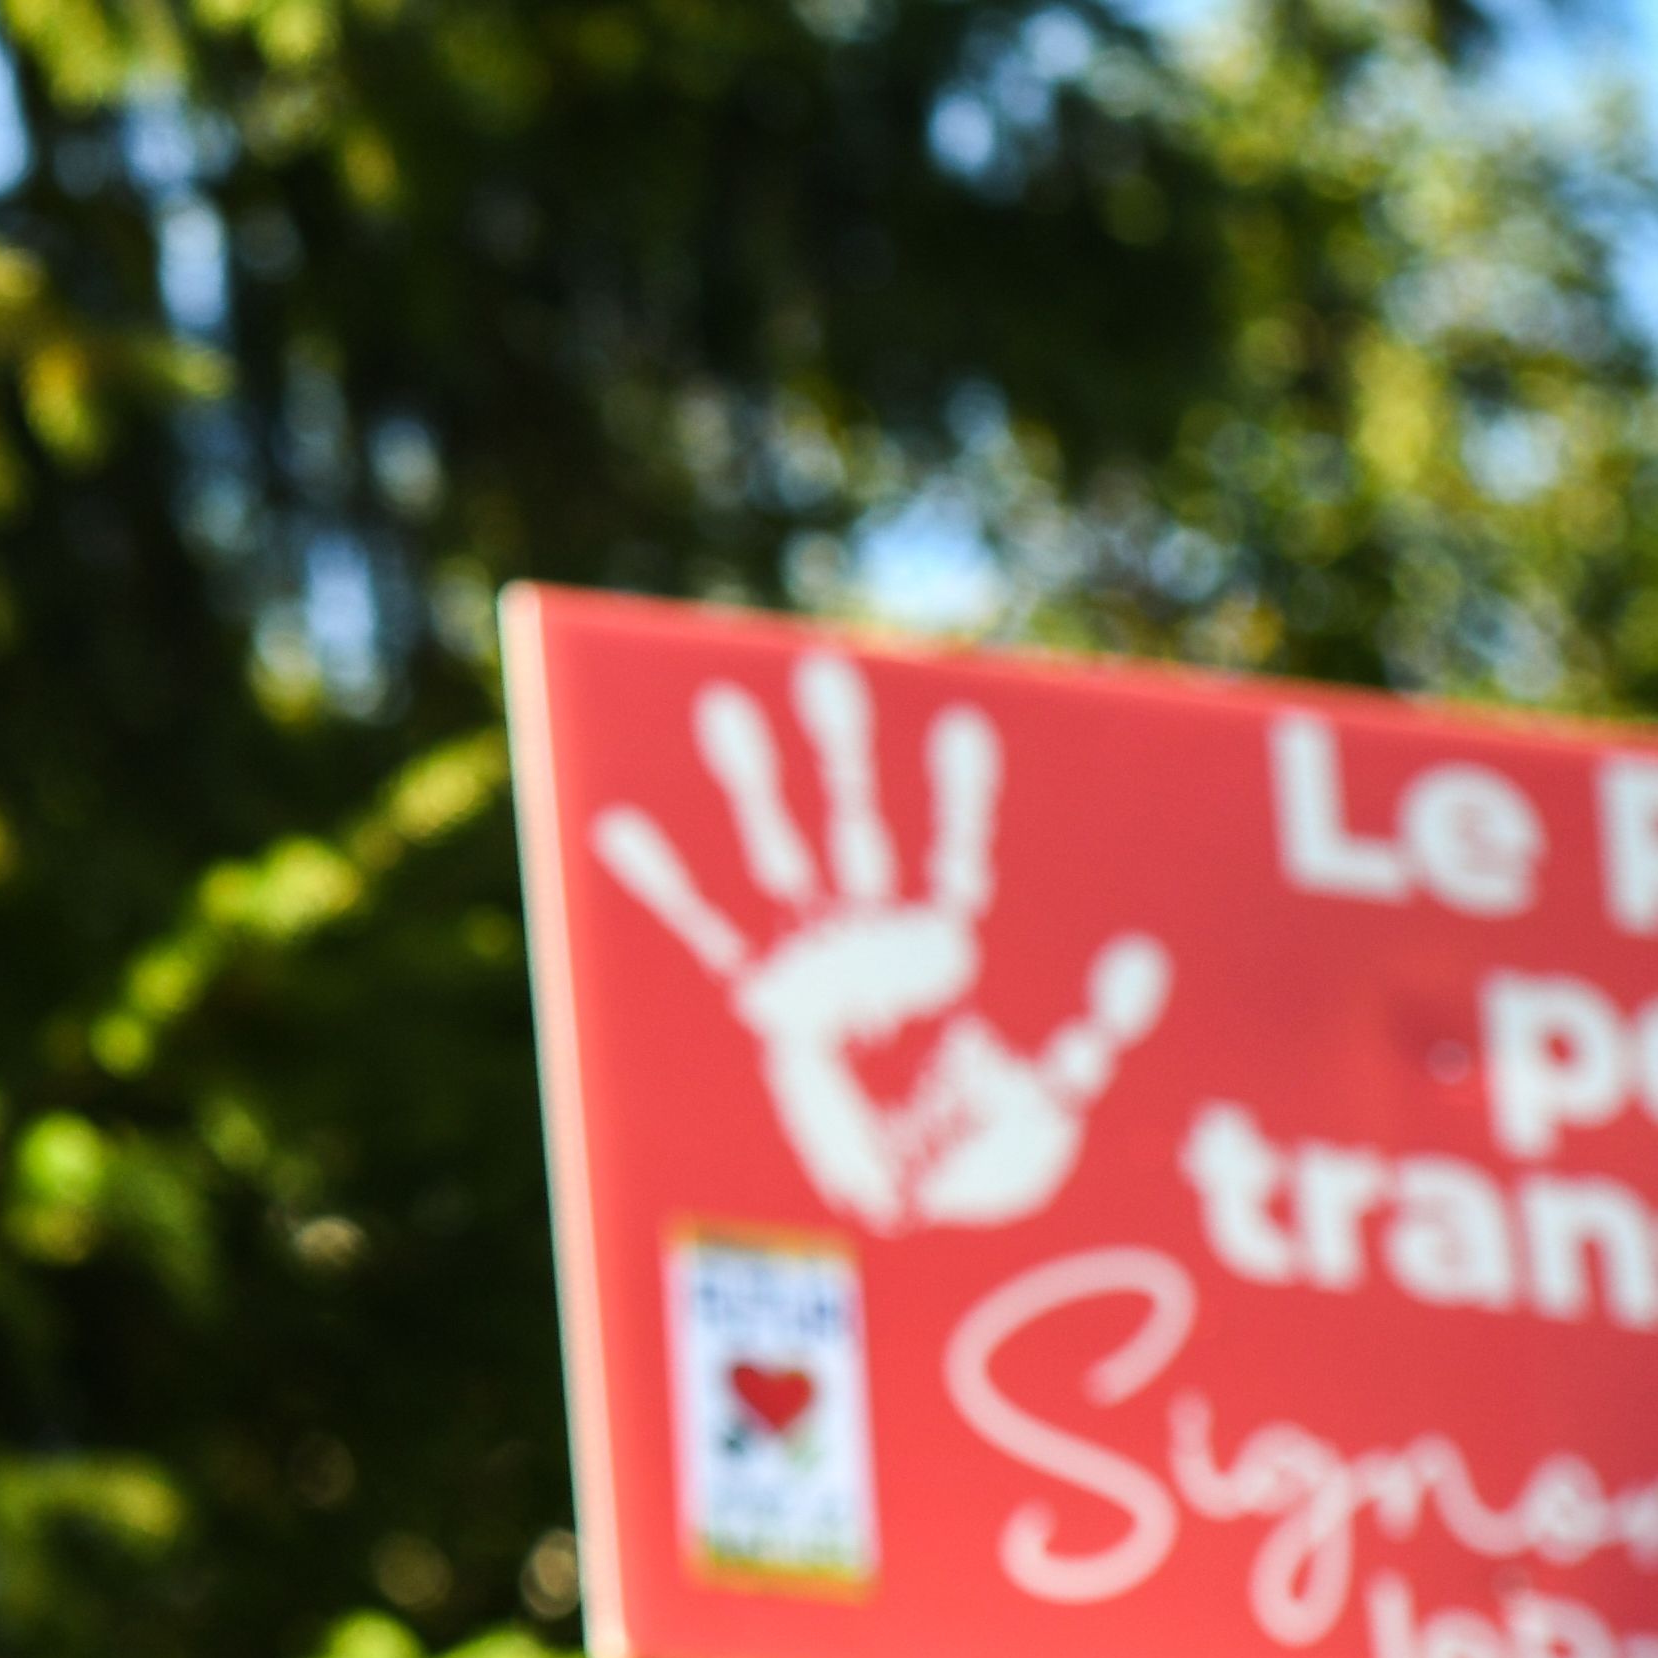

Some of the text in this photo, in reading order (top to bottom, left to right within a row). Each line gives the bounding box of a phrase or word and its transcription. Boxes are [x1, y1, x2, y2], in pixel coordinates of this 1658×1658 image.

[1269, 708, 1545, 916] Le
[1482, 972, 1658, 1160] p
[1185, 1103, 1658, 1326] tran
